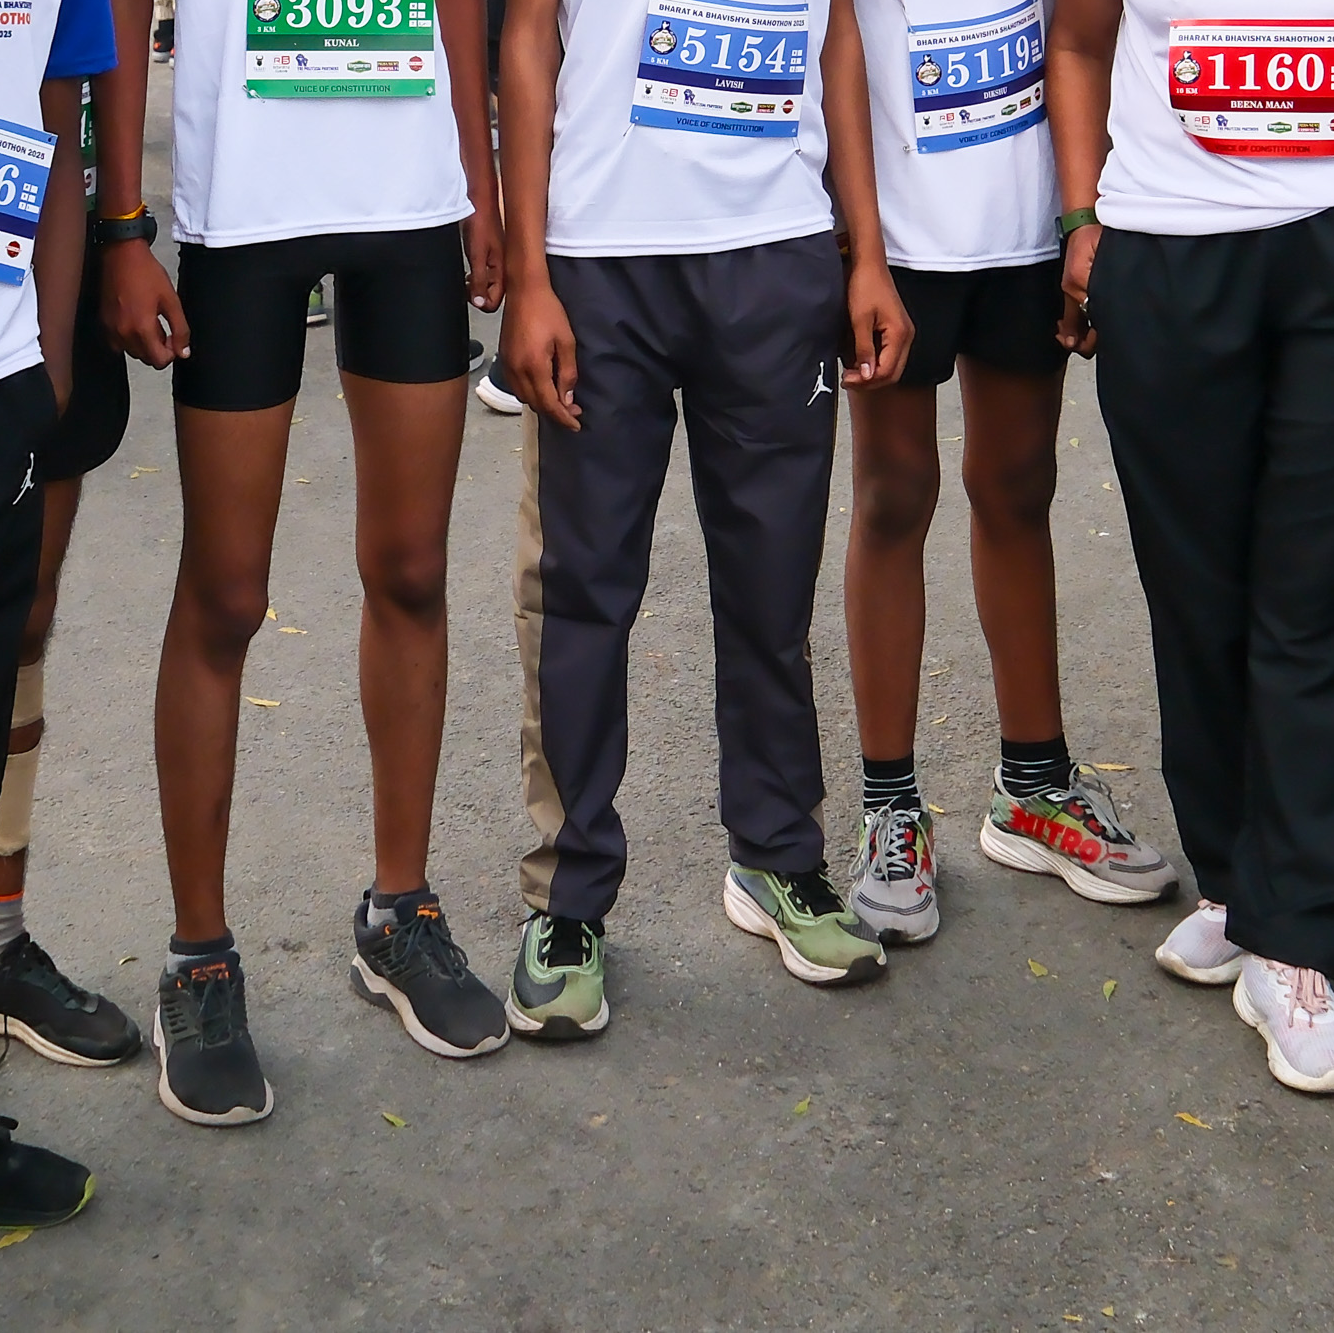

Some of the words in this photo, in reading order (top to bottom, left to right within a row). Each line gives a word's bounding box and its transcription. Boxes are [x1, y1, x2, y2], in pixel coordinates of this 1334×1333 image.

[659, 4, 690, 15] BHARAT
[692, 8, 703, 18] KA
[706, 12, 750, 24] BHAVISHYA
[752, 18, 792, 27] SHAHOTHON
[324, 39, 359, 47] KUNAL
[917, 38, 946, 46] BHARAT
[961, 29, 999, 41] BHAVISHYA
[680, 27, 786, 73] 5154
[947, 35, 1029, 88] 5119
[1208, 53, 1324, 91] 1160
[715, 79, 744, 89] LAVISH
[1231, 101, 1263, 109] BEENA
[1266, 101, 1293, 109] MAAN
[676, 118, 698, 126] VOICE
[712, 121, 764, 132] CONSTITUTION
[28, 149, 45, 160] 2025
[1004, 801, 1101, 864] NITRO
